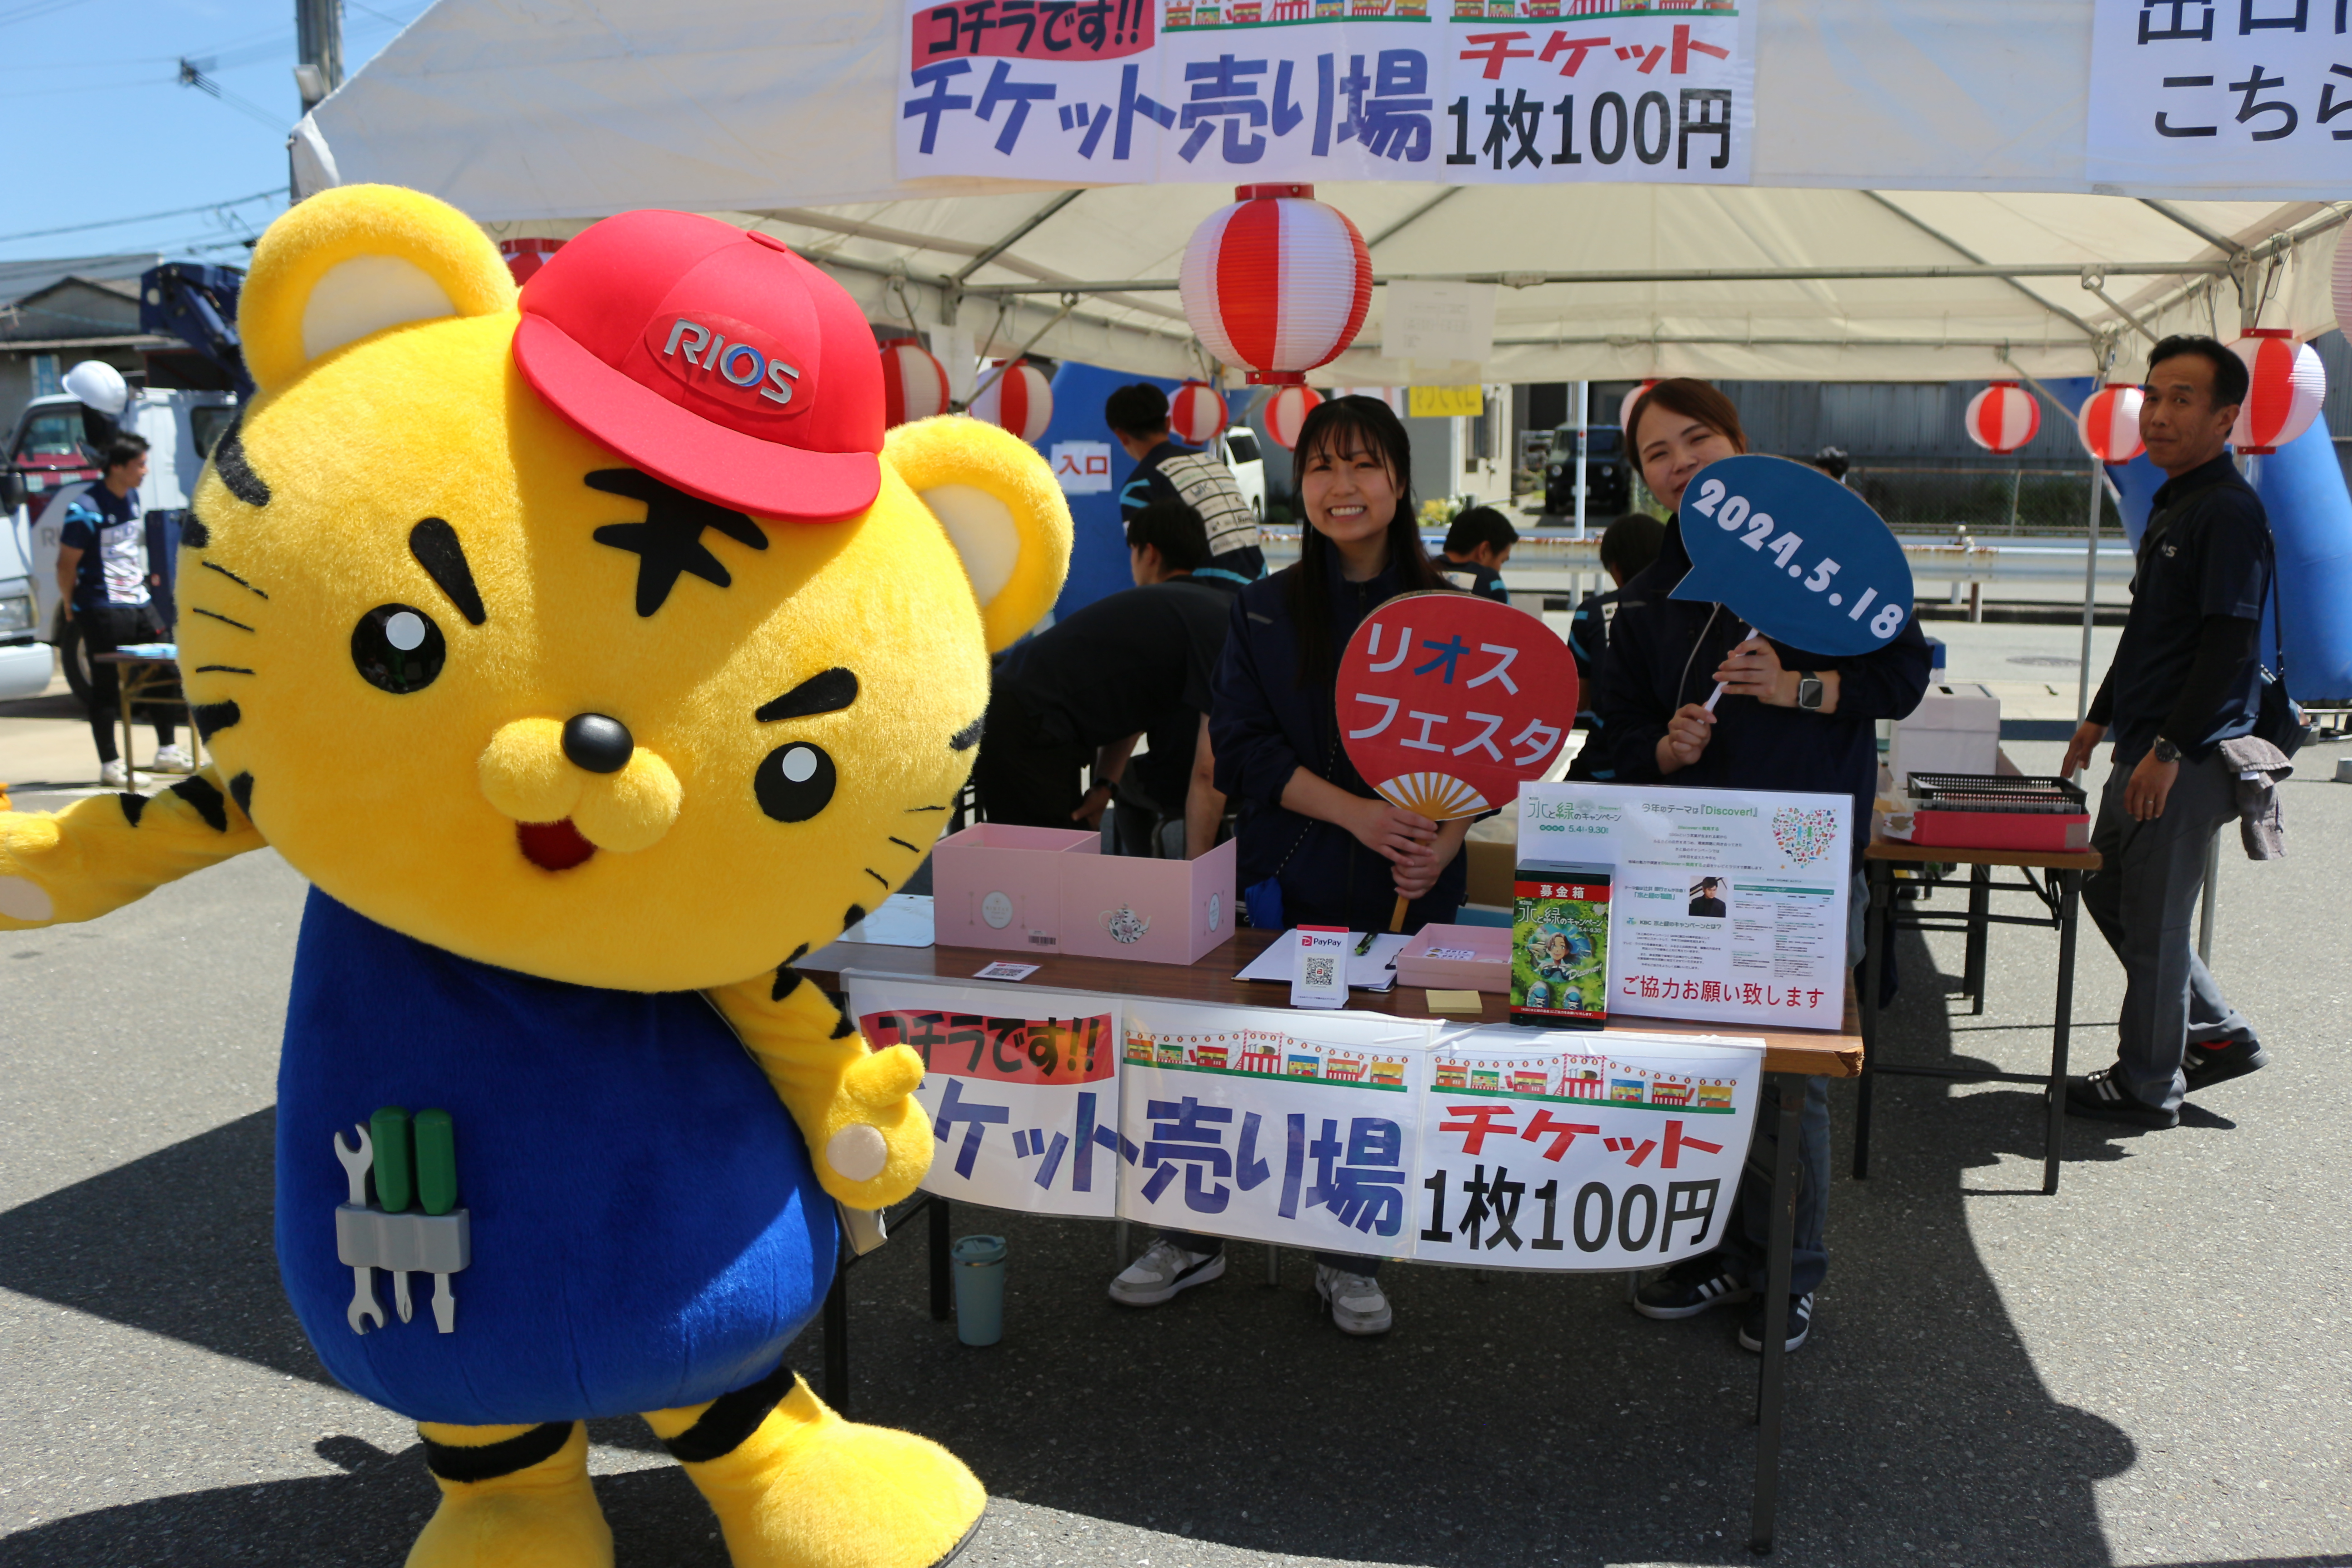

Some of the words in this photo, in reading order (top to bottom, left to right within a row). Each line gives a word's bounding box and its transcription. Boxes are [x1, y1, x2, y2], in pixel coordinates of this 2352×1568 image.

[928, 0, 1143, 54] コチラです!!
[1459, 24, 1730, 80] チケット
[2137, 0, 2347, 45] 出口
[903, 49, 1433, 163] チケット売り場
[1446, 88, 1732, 170] 1枚100円
[664, 317, 800, 404] RIOS
[1058, 455, 1108, 475] 入口
[1691, 479, 1904, 639] 2024.5.18
[1367, 622, 1519, 696] リオス
[1349, 692, 1562, 766] フェスタ
[1528, 800, 1622, 821] 水と緑のキャンペーン
[1518, 905, 1603, 926] 水と緑のキャンペーン
[1540, 884, 1585, 899] 募金箱
[1313, 937, 1342, 947] PayPay
[1623, 975, 1824, 1009] ご協力お願い致します
[917, 1077, 1406, 1237] ケット売り場
[1439, 1105, 1724, 1169] チケット
[1420, 1164, 1721, 1253] 1枚100円
